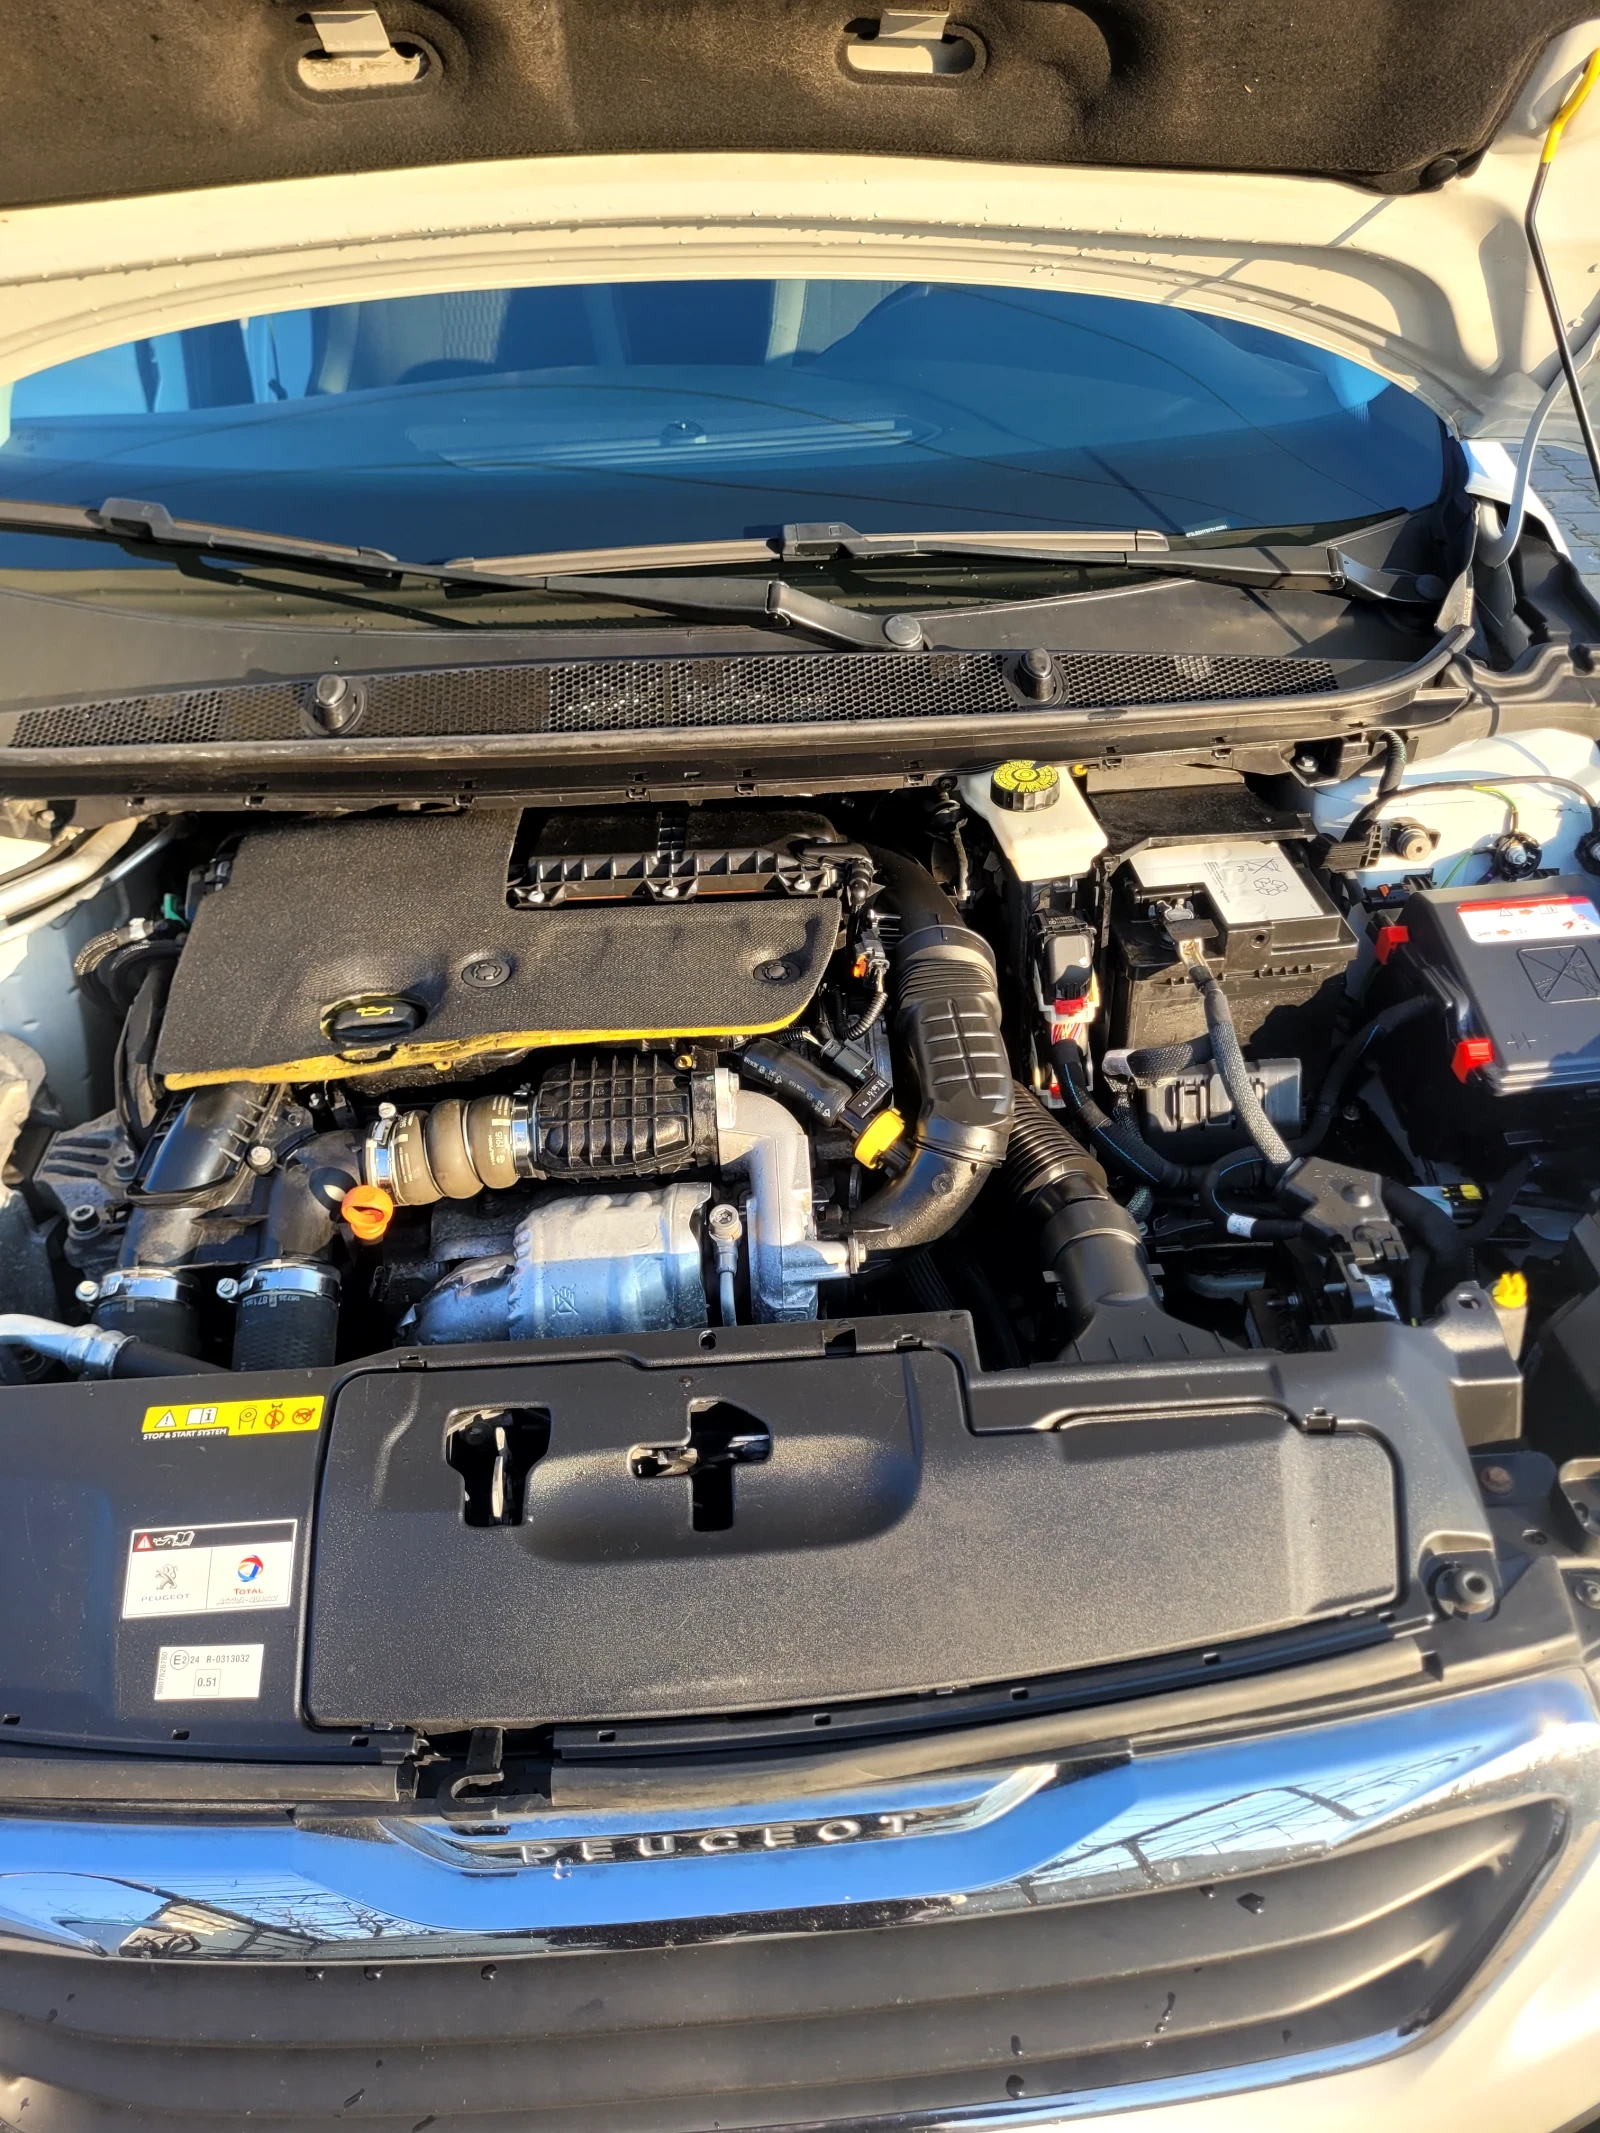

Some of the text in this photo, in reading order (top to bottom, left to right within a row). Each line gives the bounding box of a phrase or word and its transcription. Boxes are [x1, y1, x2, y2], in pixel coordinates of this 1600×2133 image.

[143, 1432, 163, 1440] STOP
[171, 1430, 197, 1438] START
[197, 1428, 228, 1437] SYSTEM
[141, 1593, 191, 1602] PEUGEOT
[190, 1655, 200, 1664] 24
[206, 1654, 250, 1664] R-0313032
[197, 1677, 217, 1687] 0.51
[520, 1812, 920, 1866] PEUGEOT
